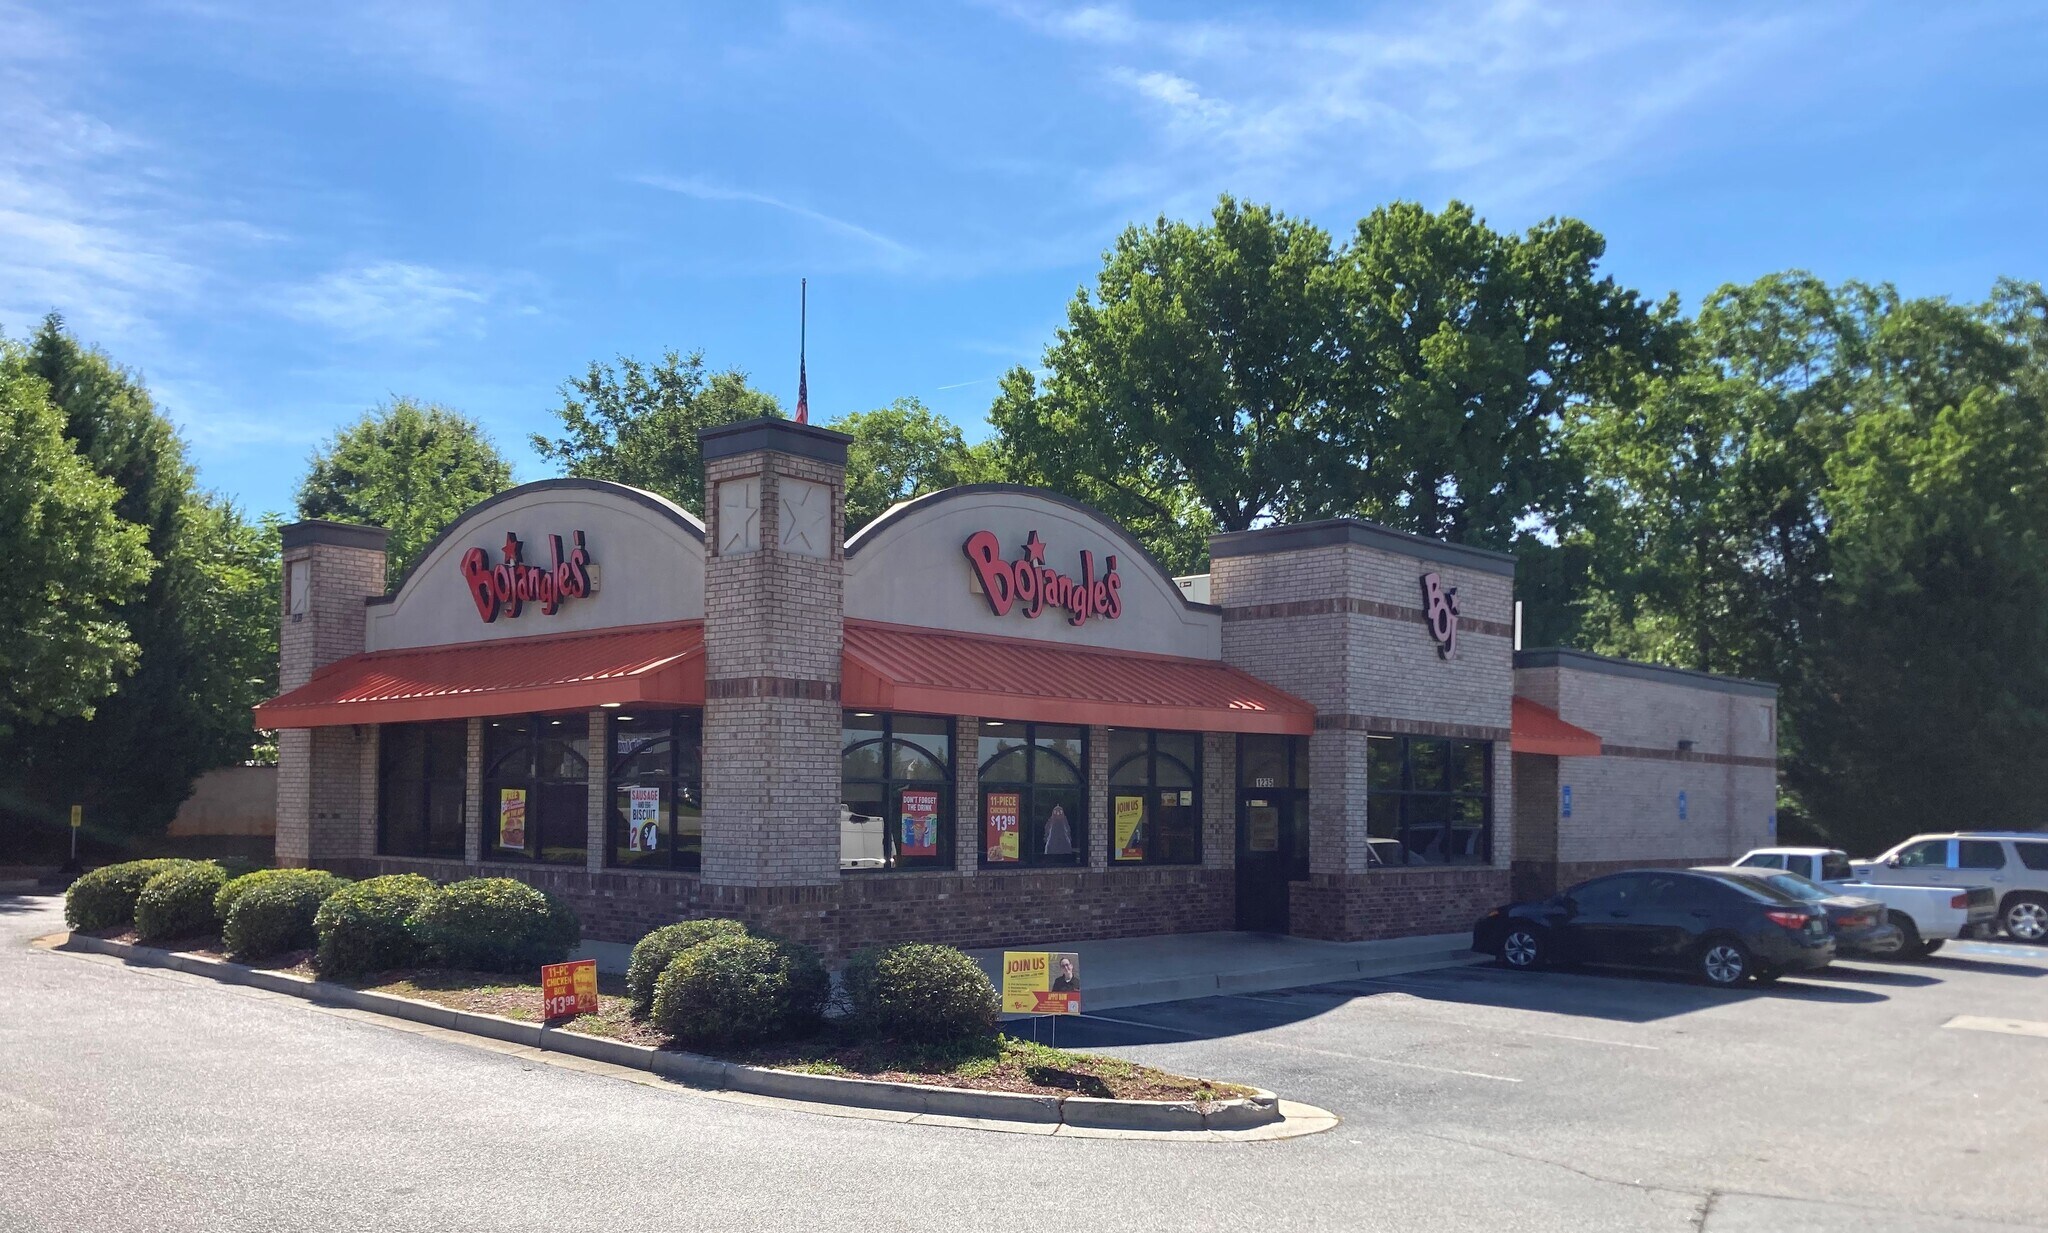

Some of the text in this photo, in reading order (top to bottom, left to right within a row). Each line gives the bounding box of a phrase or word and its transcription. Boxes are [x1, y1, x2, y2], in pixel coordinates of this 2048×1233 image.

[632, 789, 658, 801] SAUSAGE
[903, 795, 937, 805] DON'T FORGET
[990, 796, 1017, 806] 11-PIECE
[907, 803, 933, 812] THE DRINK
[1117, 801, 1131, 815] JOIN
[1130, 800, 1139, 811] US
[632, 808, 657, 820] BISCUIT
[548, 965, 569, 977] 11-PC
[1006, 957, 1045, 974] JOIN US
[546, 976, 572, 987] CHICKEN
[553, 986, 567, 996] BOX
